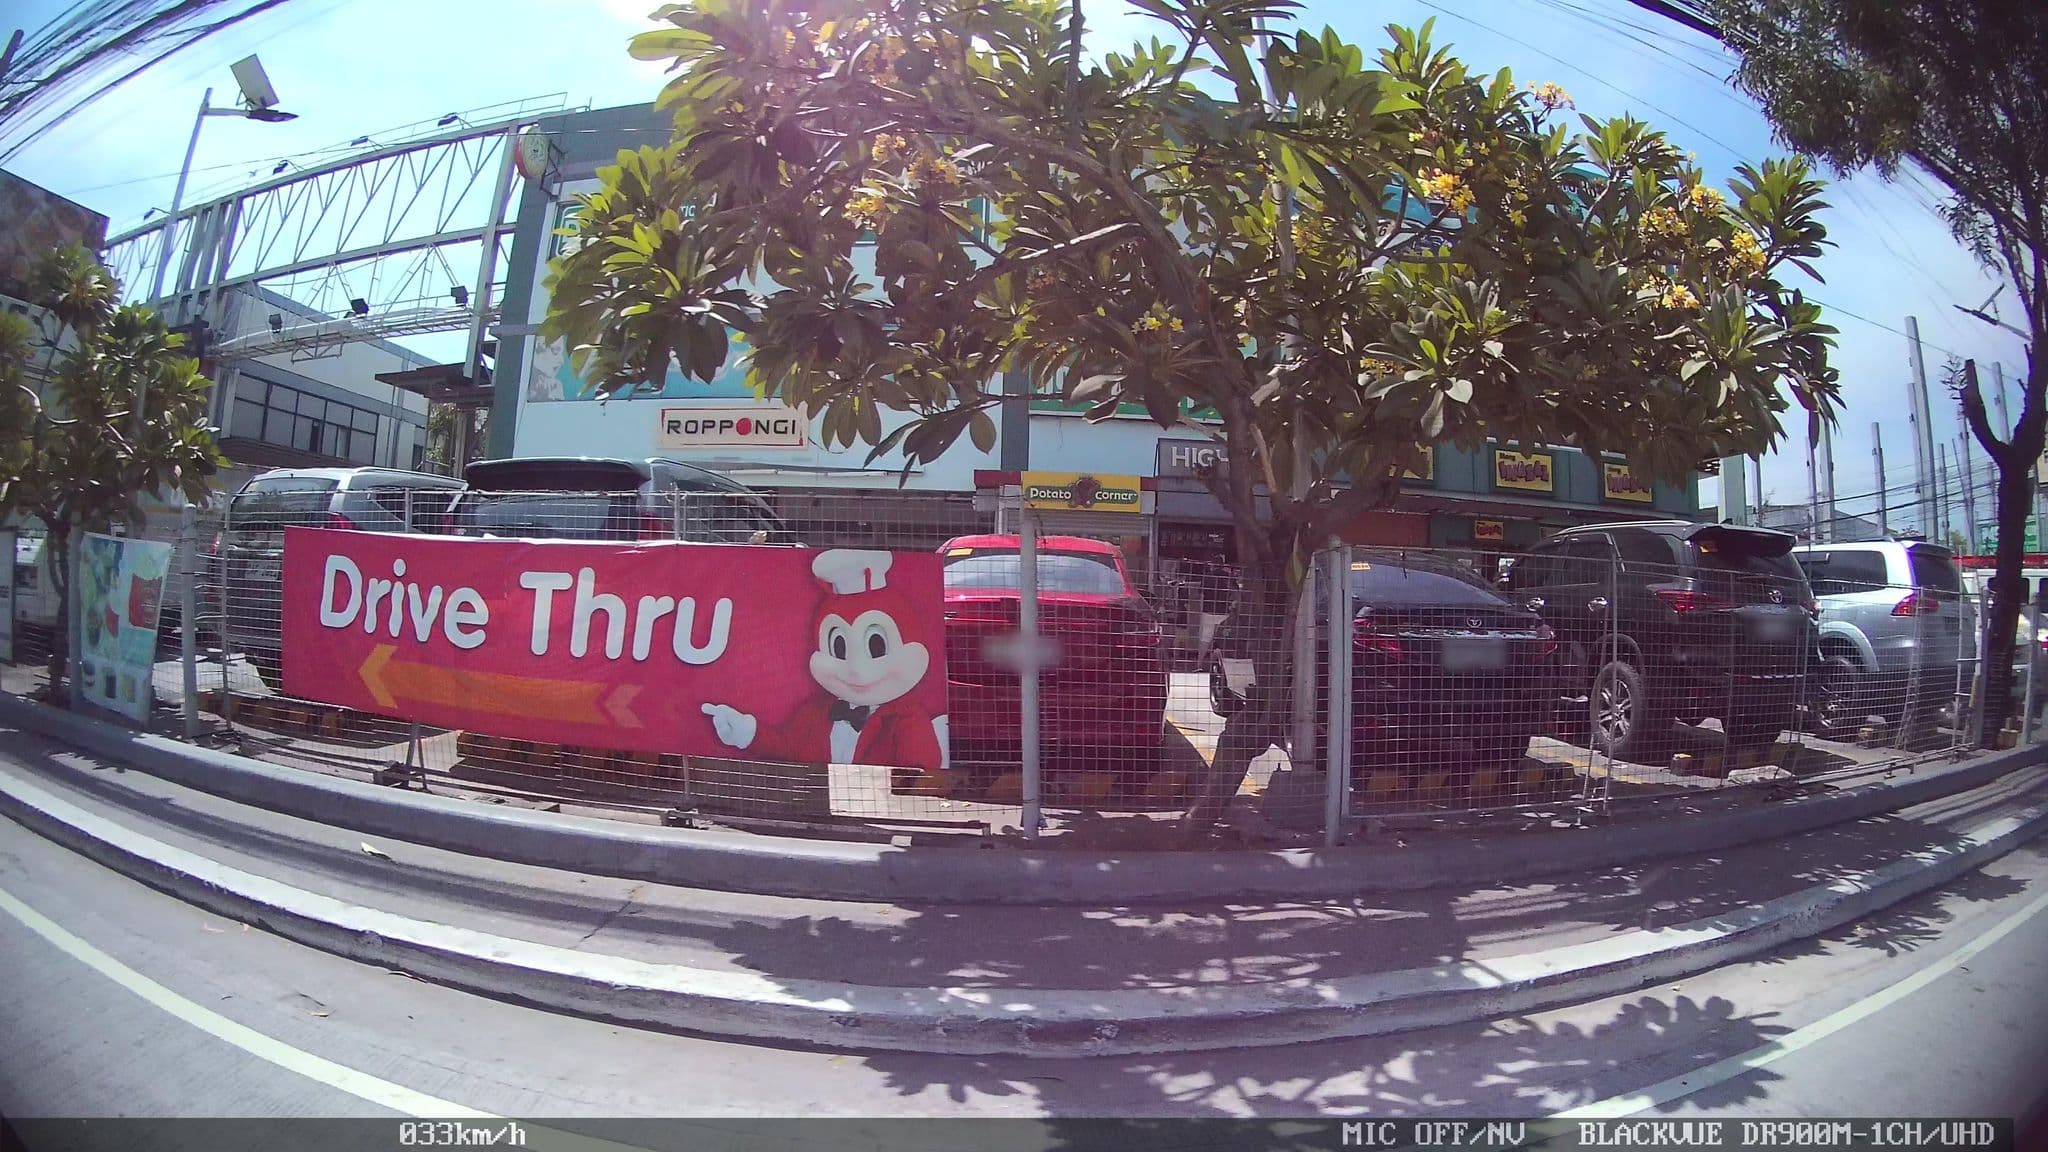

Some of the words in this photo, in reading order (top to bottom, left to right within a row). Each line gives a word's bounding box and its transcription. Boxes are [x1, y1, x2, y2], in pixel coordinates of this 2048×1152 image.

[667, 417, 797, 436] ROPPONGI
[1029, 487, 1072, 500] Potato
[320, 553, 490, 650] Drive
[519, 566, 733, 666] Thru
